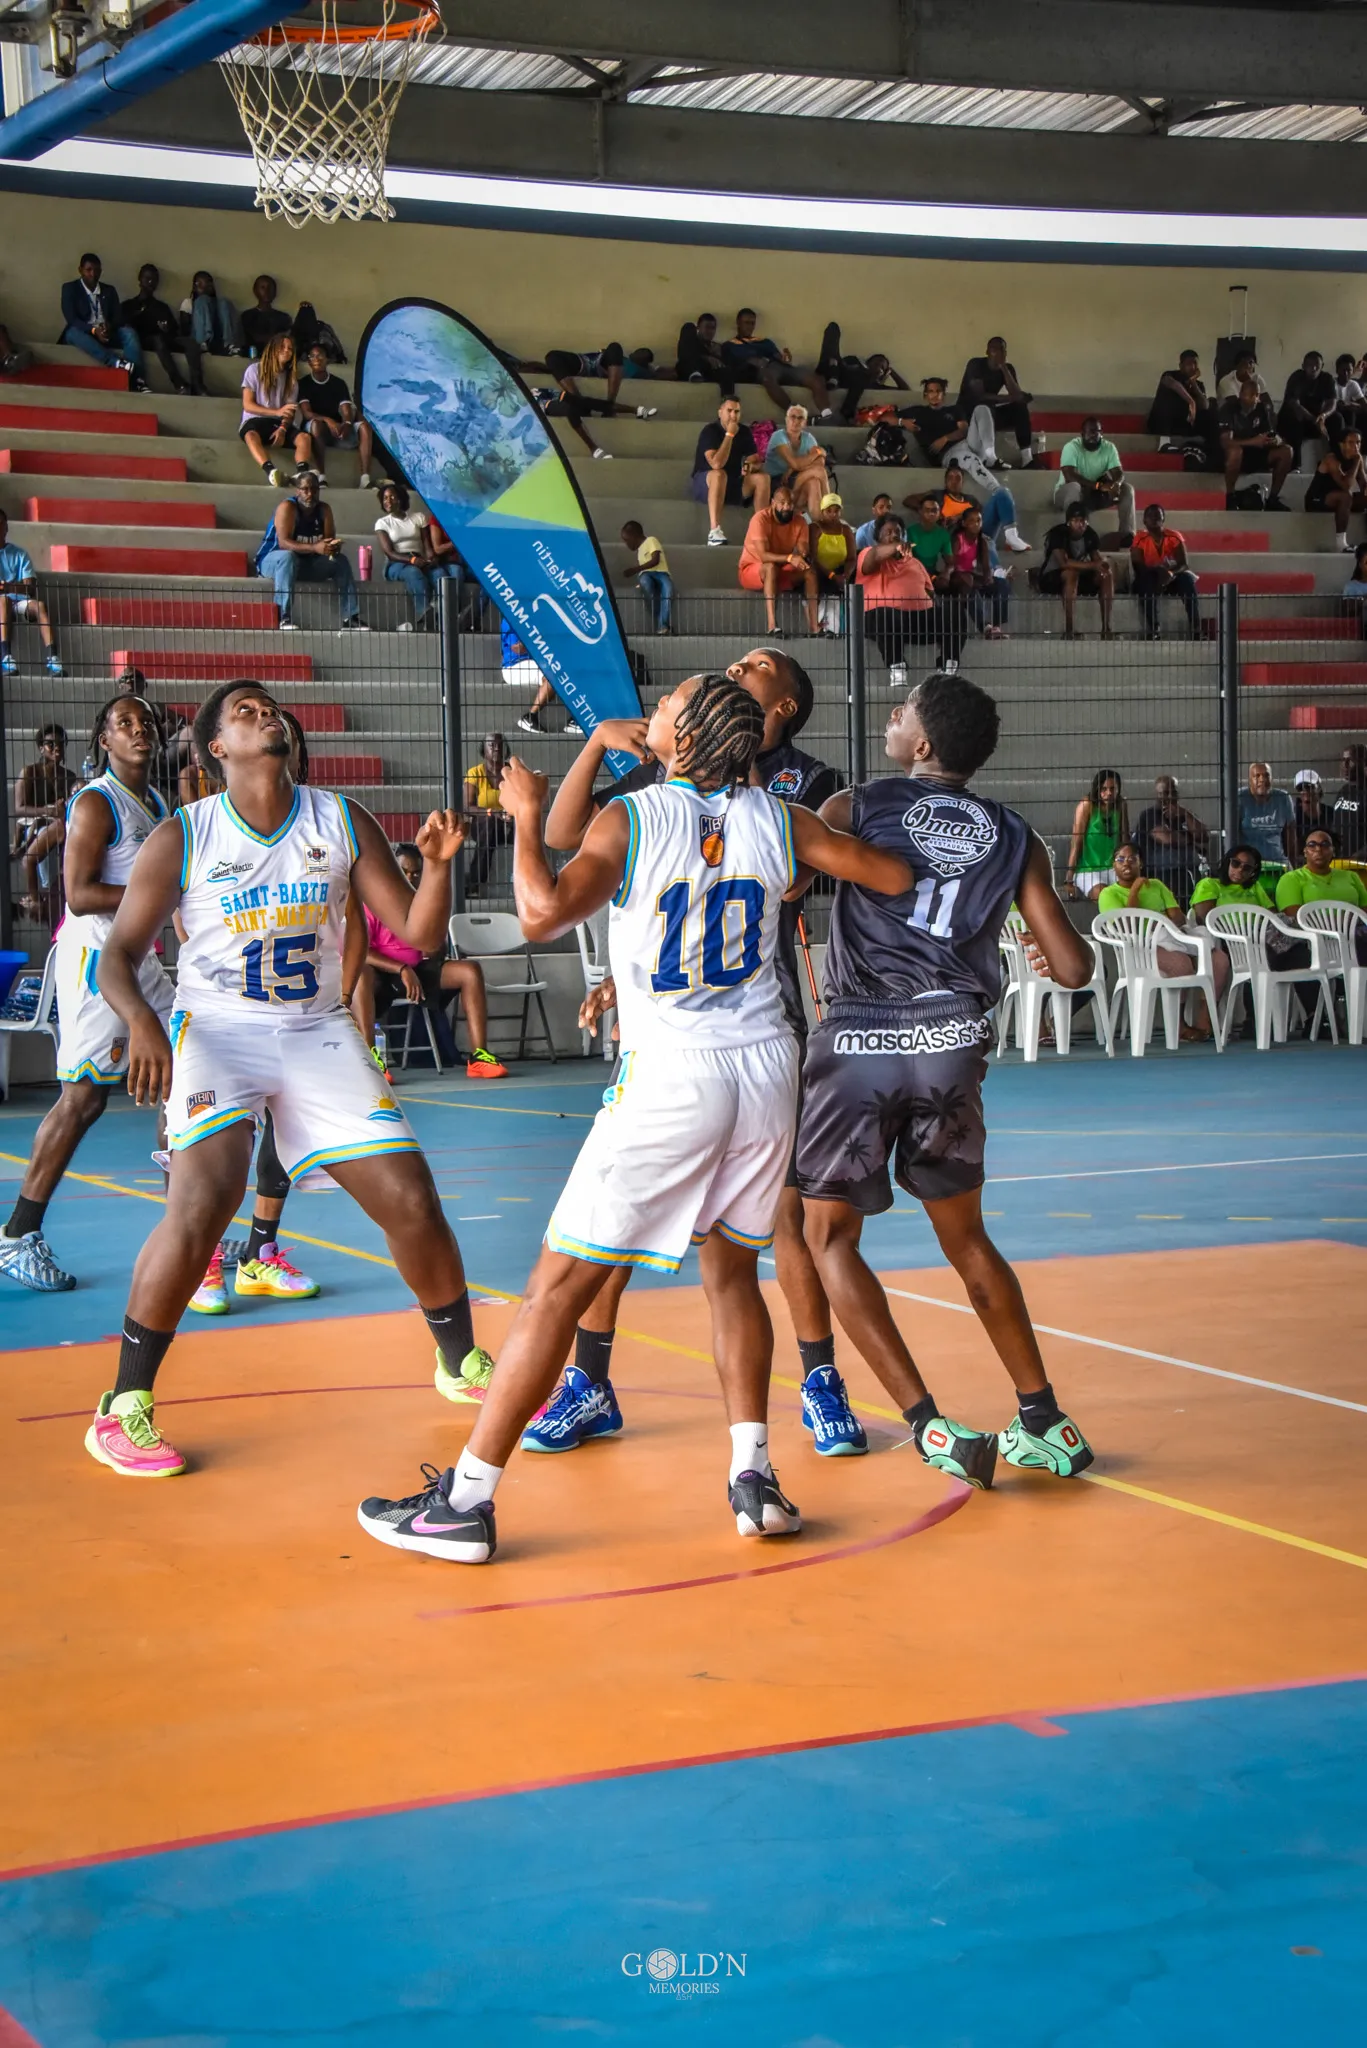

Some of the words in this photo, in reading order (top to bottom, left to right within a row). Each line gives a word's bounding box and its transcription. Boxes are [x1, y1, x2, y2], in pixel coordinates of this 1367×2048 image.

[220, 882, 329, 915] SAINT-BARTH
[907, 877, 961, 938] 11
[239, 931, 320, 1004] 15
[648, 874, 768, 996] 10
